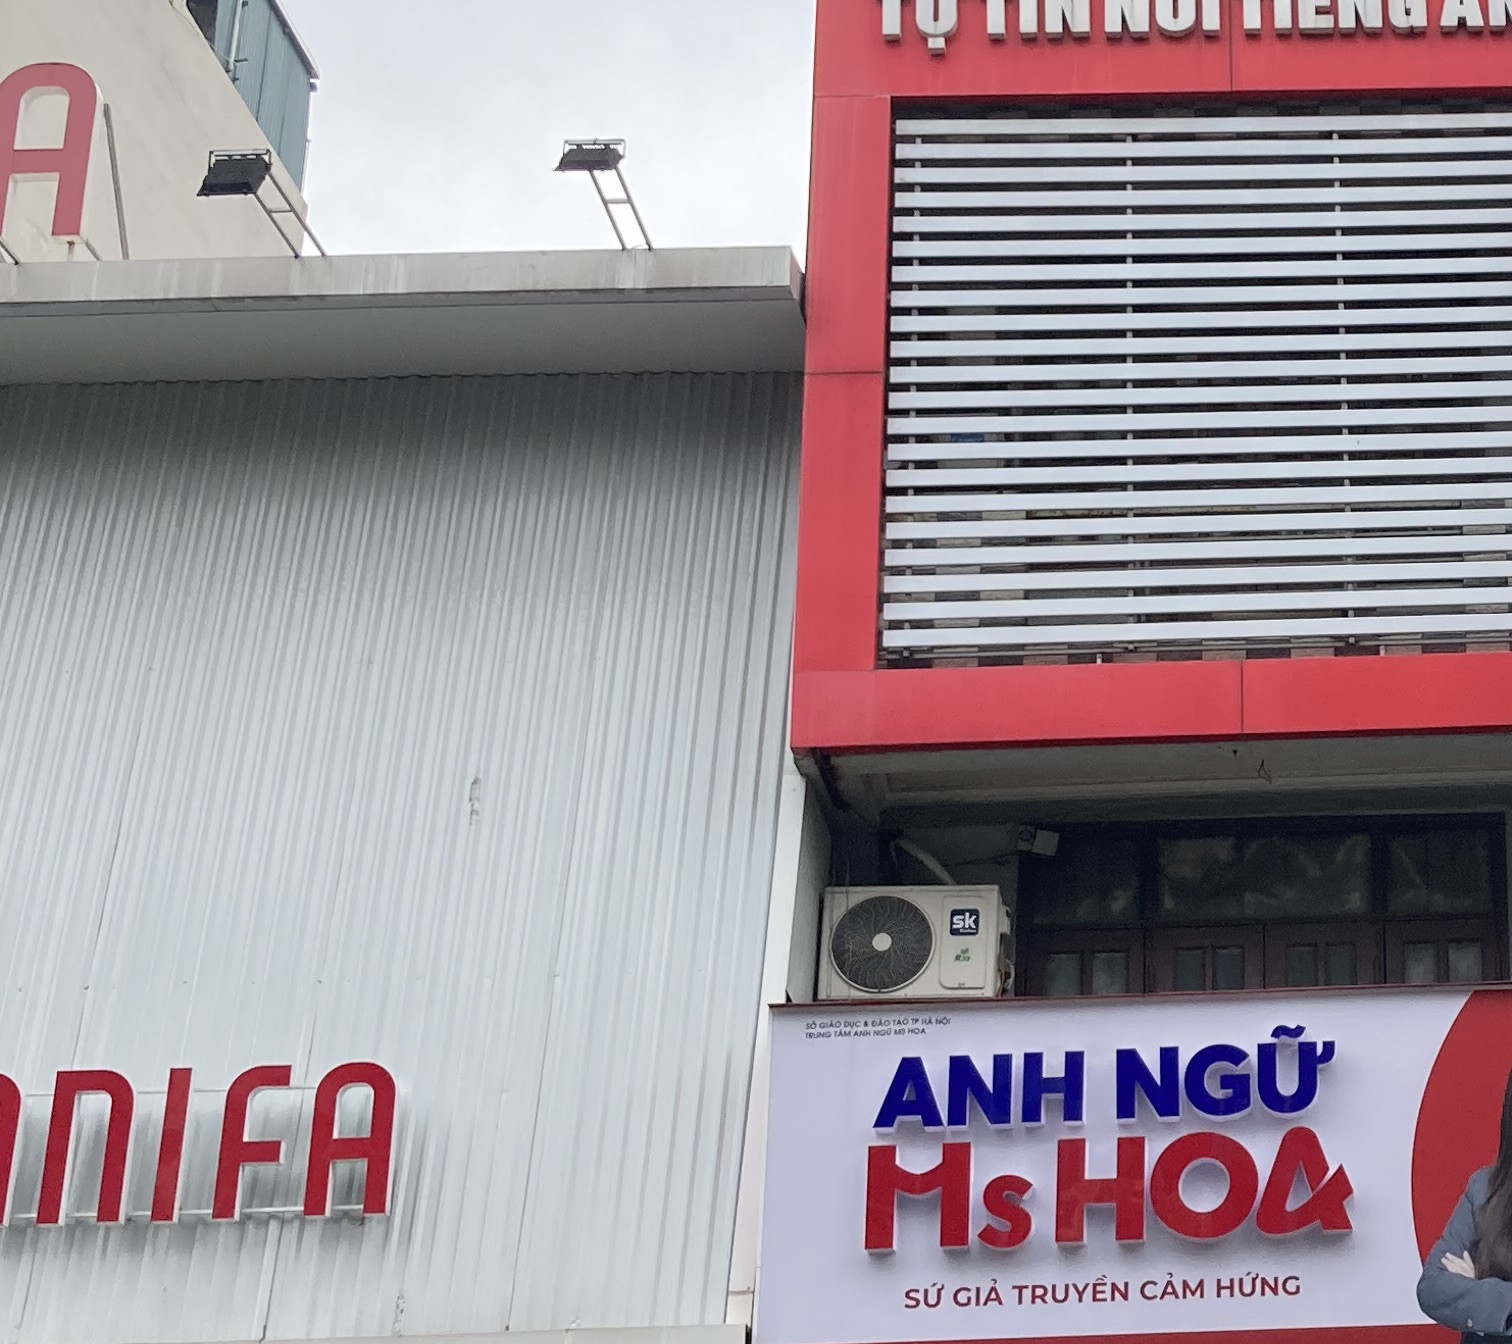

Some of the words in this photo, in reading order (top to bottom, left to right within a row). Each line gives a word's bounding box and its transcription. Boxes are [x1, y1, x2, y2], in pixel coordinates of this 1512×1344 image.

[873, 1050, 1085, 1130] ANH
[1115, 1025, 1335, 1122] NGỮ
[0, 1062, 398, 1226] NIFA
[904, 1281, 945, 1309] SỨ
[953, 1278, 1004, 1308] GIẢ
[1012, 1274, 1130, 1305] TRUYỀN
[1140, 1273, 1205, 1302] CẢM
[1215, 1271, 1302, 1299] HỨNG
